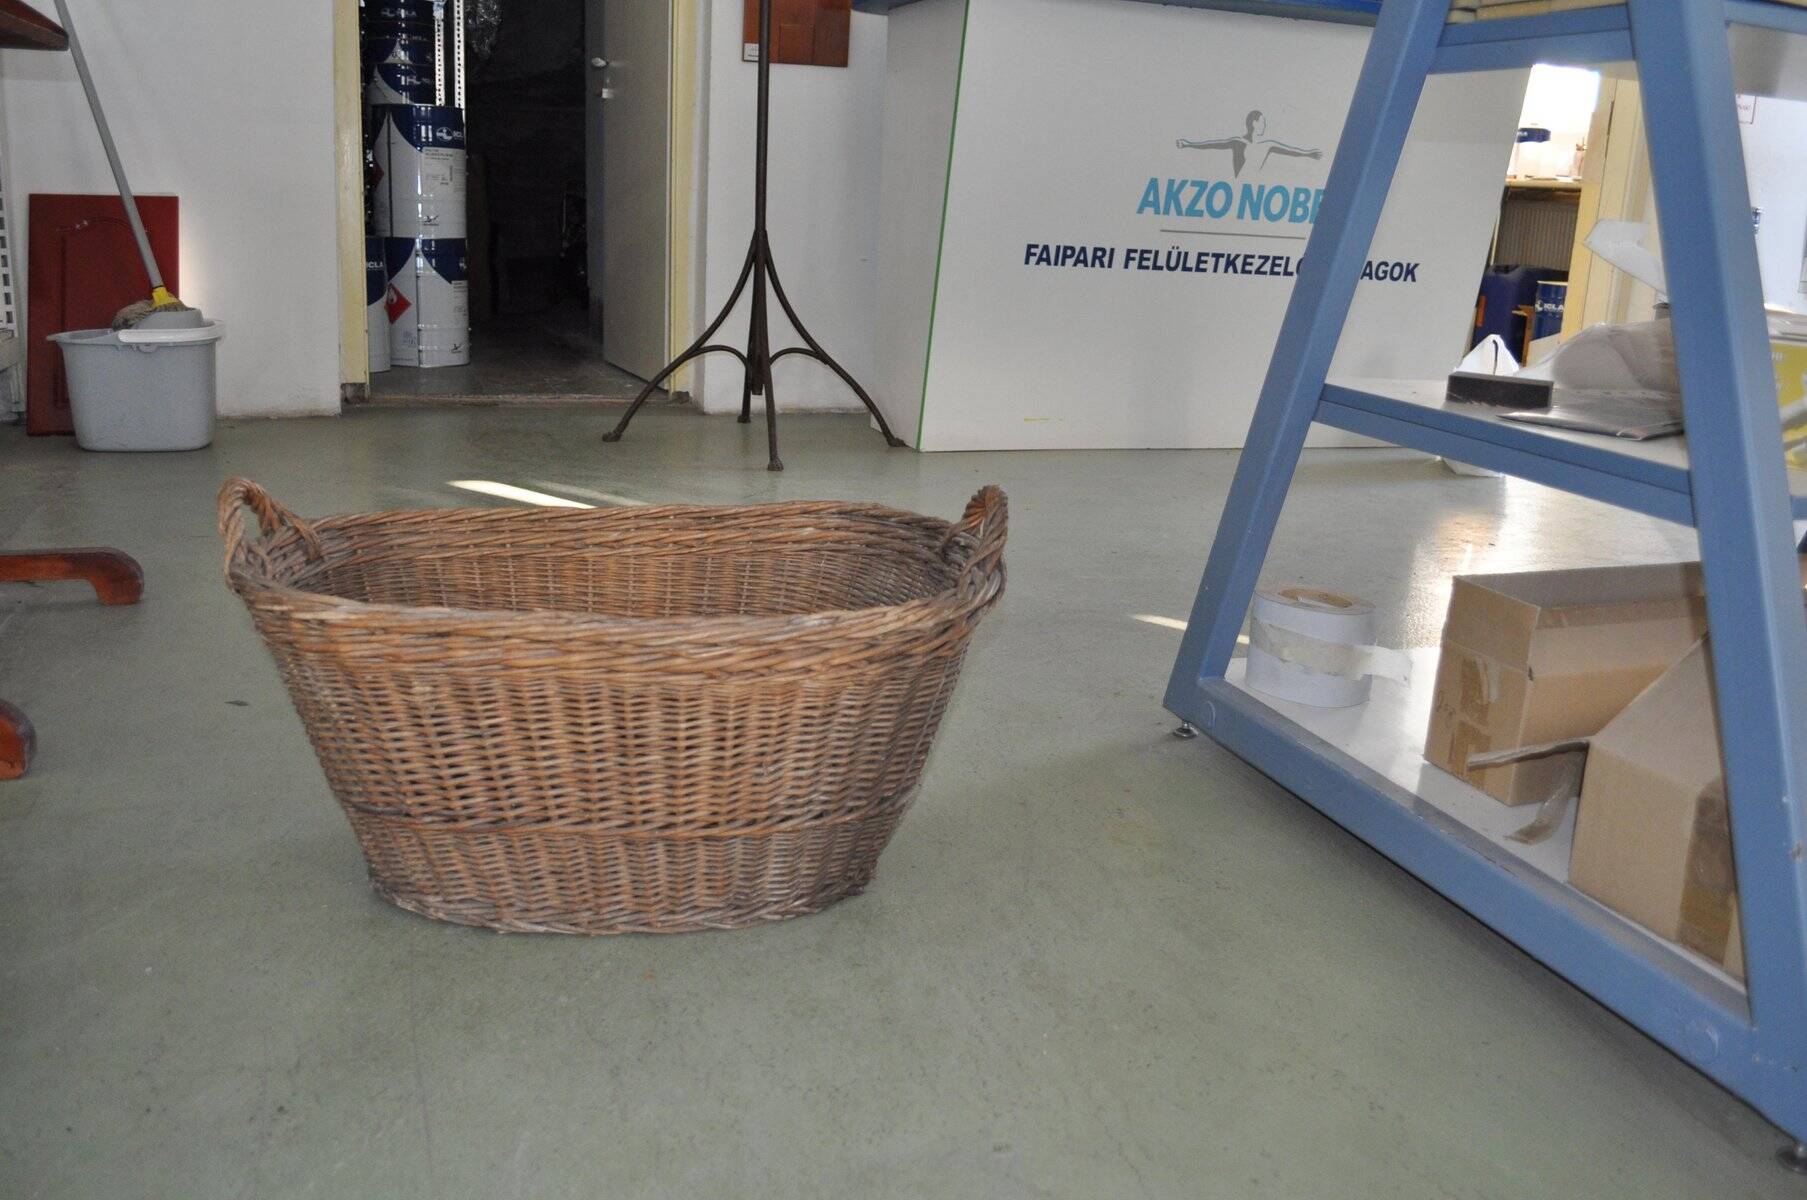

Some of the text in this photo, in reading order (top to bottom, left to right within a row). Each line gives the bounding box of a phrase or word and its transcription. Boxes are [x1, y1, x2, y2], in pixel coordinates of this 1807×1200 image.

[1137, 178, 1233, 219] AKZO
[1024, 243, 1420, 283] FAIPARI FELÜLETKEZEL AGOK
